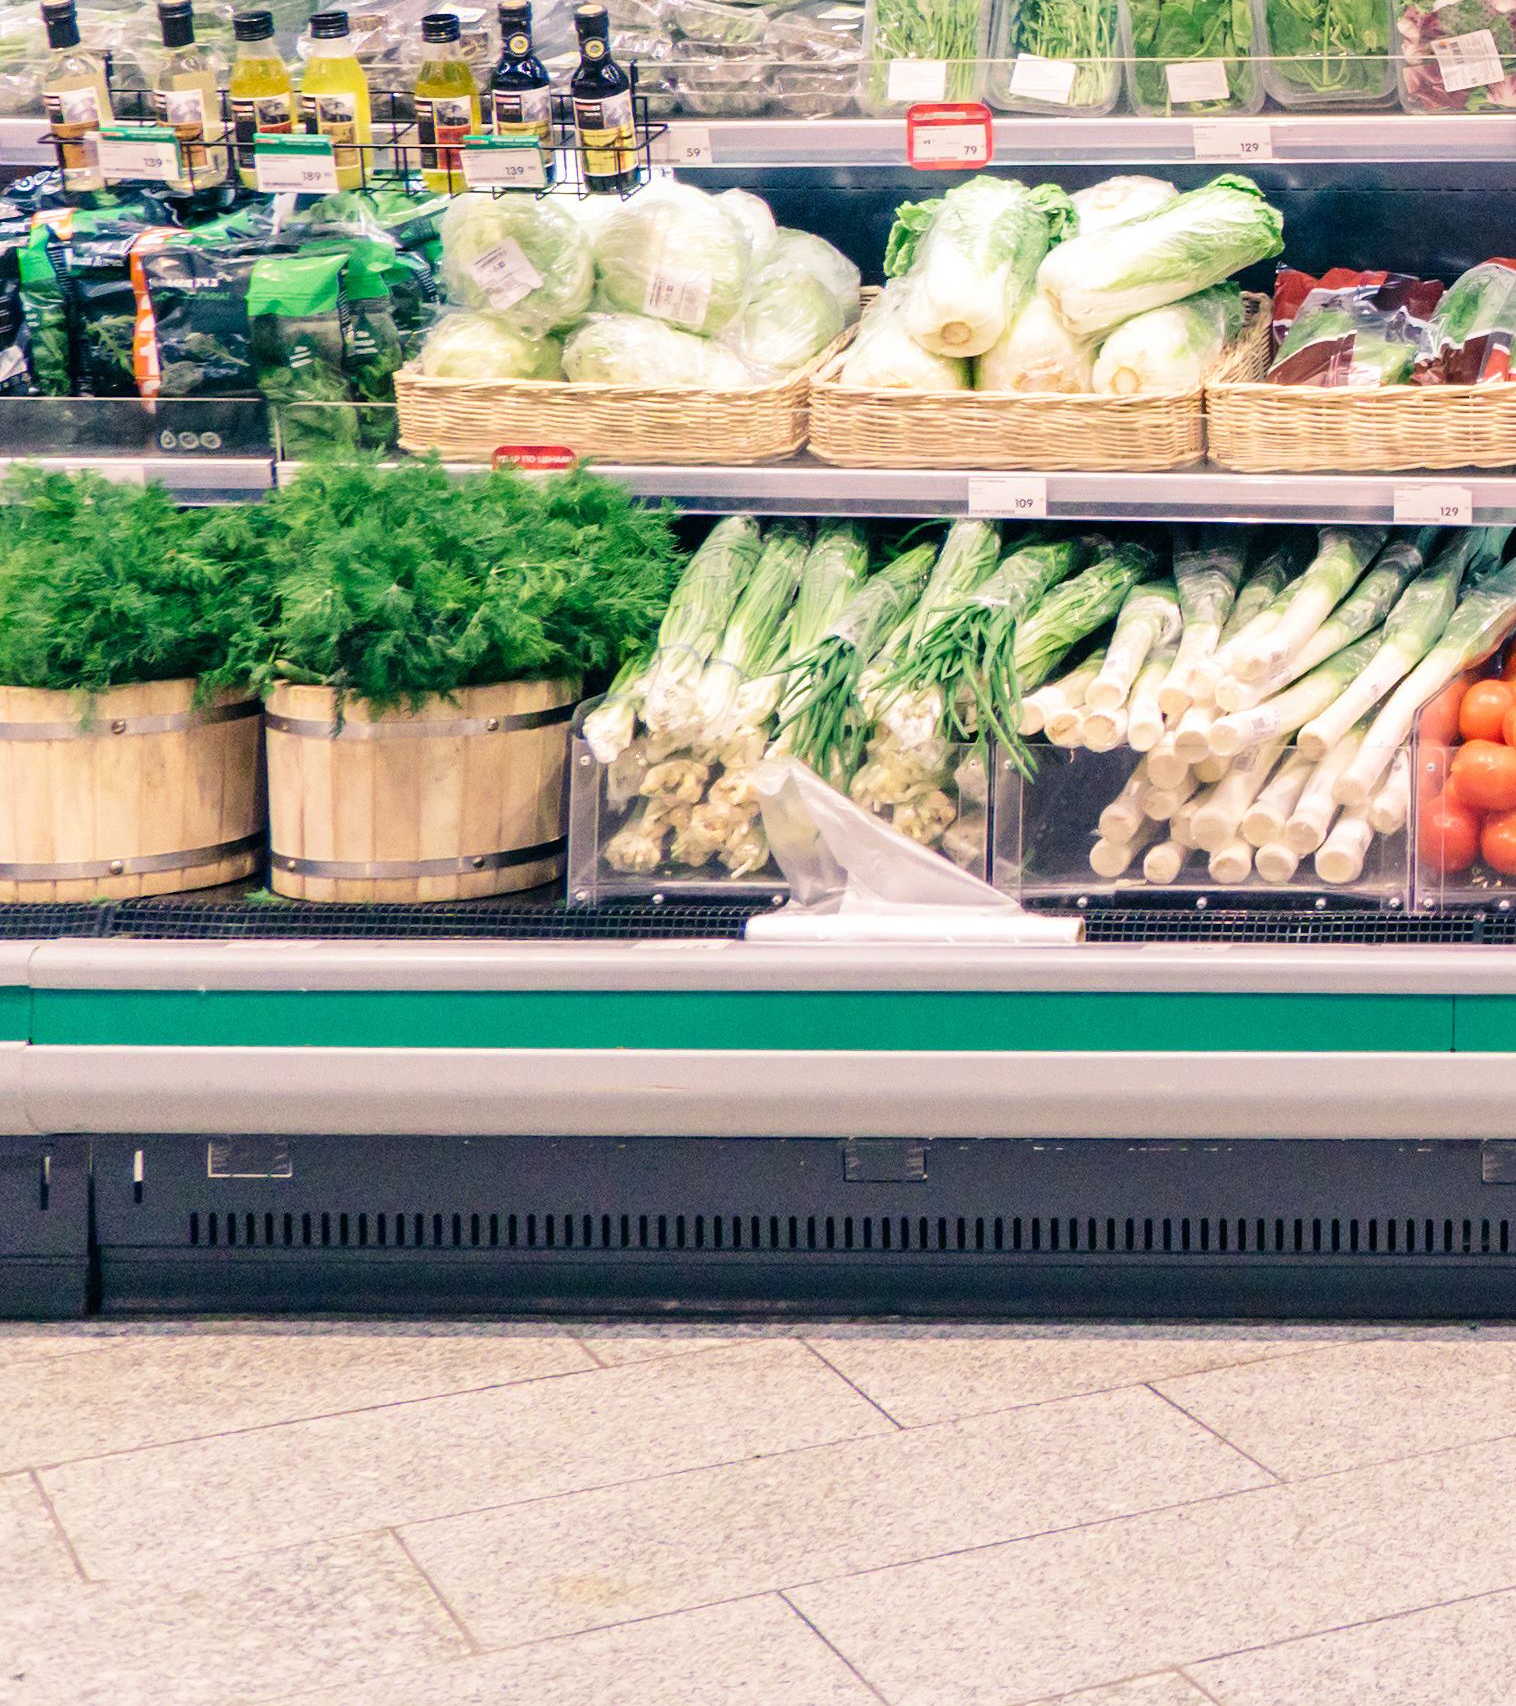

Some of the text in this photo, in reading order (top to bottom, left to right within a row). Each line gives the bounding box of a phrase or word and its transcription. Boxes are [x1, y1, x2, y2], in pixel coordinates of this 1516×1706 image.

[686, 147, 701, 157] 59
[964, 145, 977, 155] 79
[1240, 142, 1259, 152] 129
[505, 166, 524, 175] 139
[302, 171, 321, 181] 189
[1015, 498, 1034, 509] 109
[1440, 506, 1459, 517] 129
